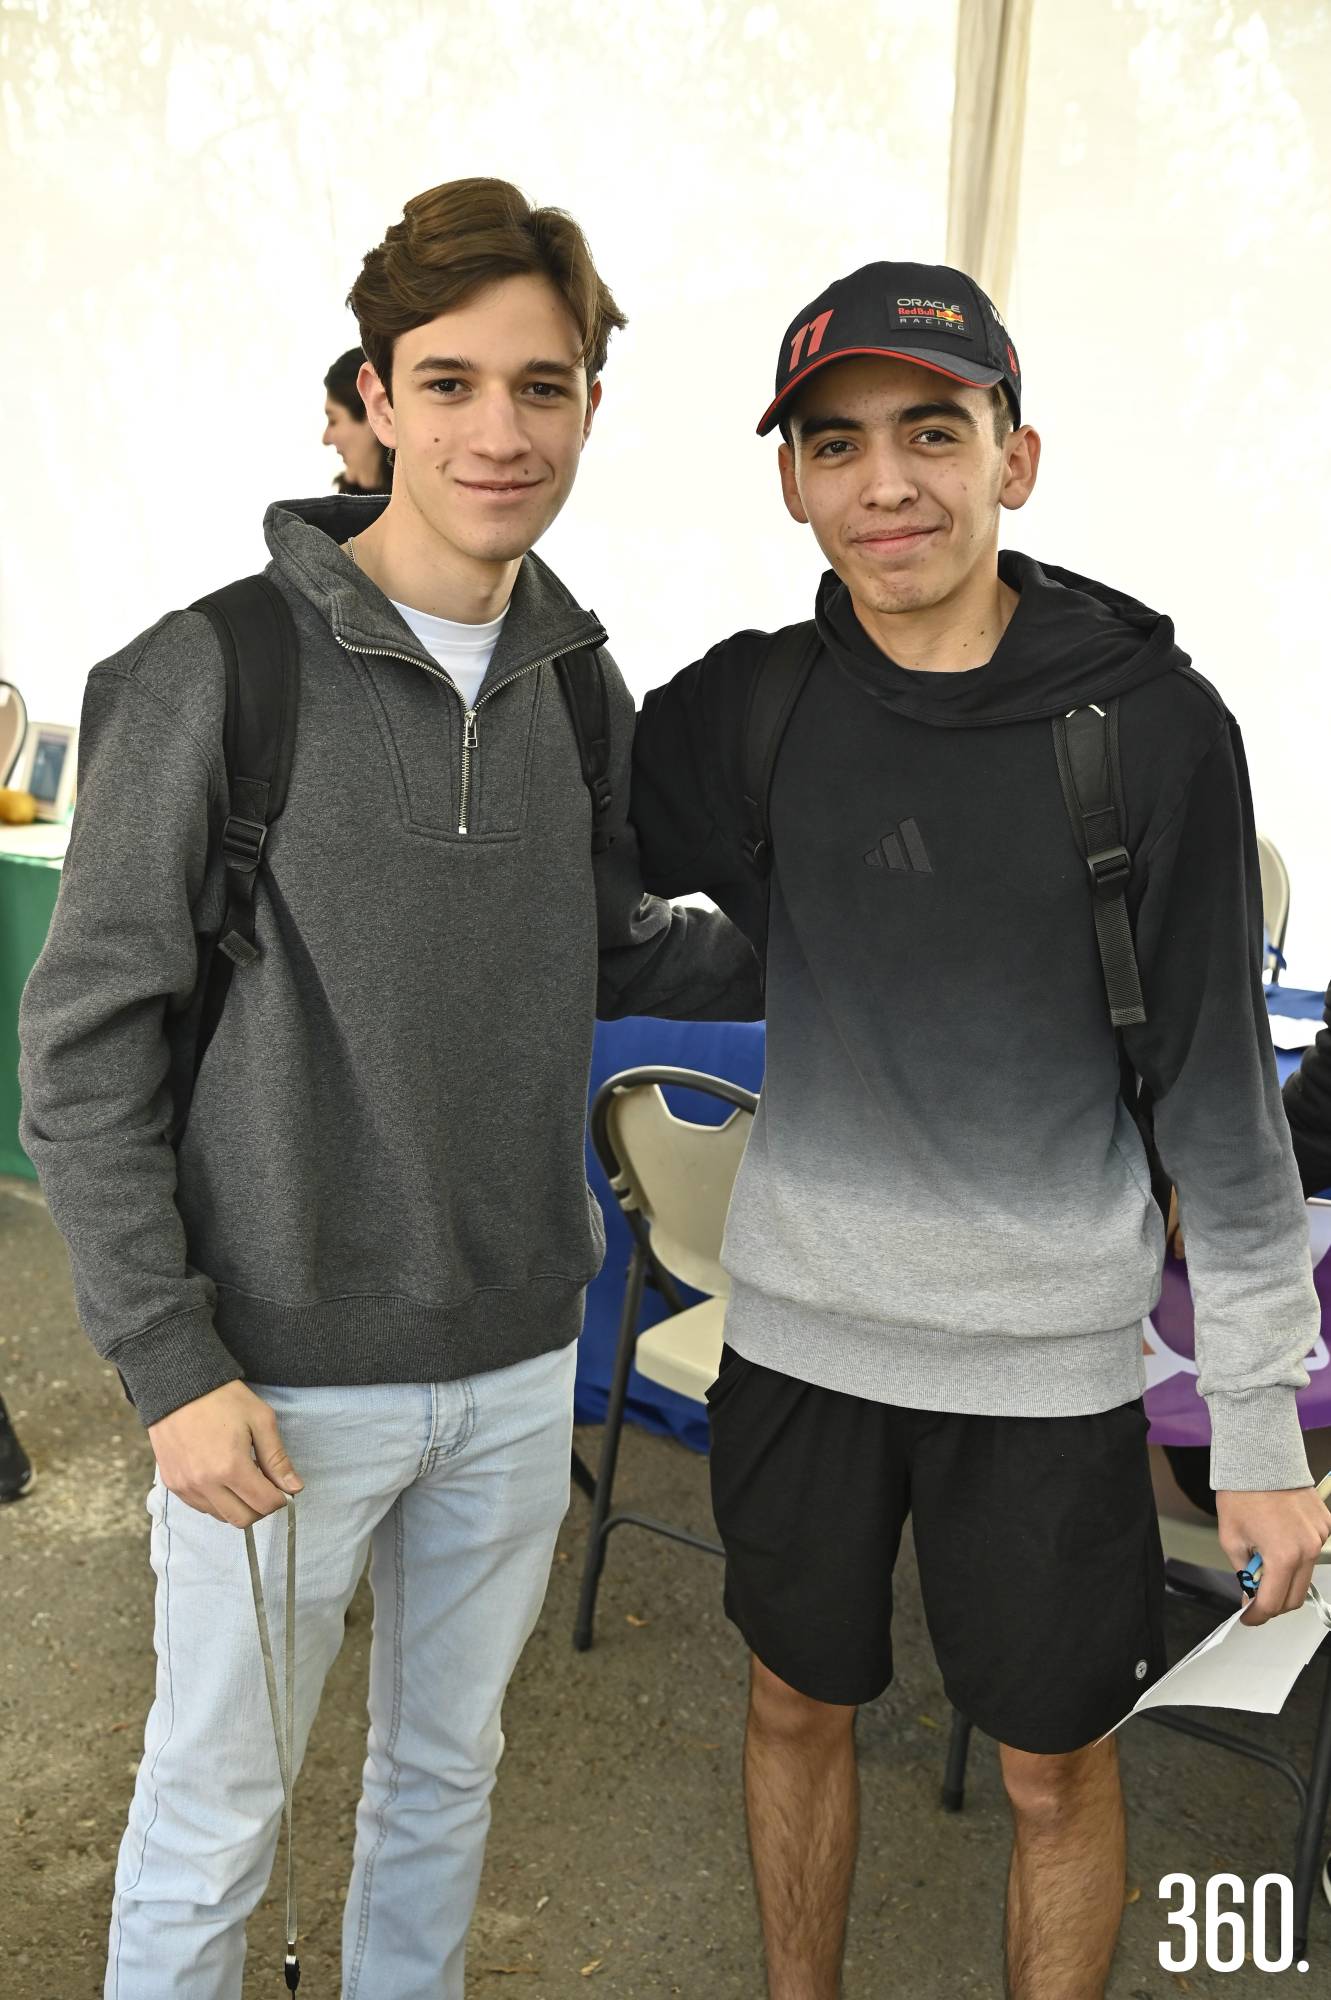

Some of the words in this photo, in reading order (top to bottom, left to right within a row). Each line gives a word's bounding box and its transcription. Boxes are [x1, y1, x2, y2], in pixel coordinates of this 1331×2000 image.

[897, 298, 961, 313] ORACLE
[900, 318, 965, 331] RACING
[789, 309, 834, 372] 11
